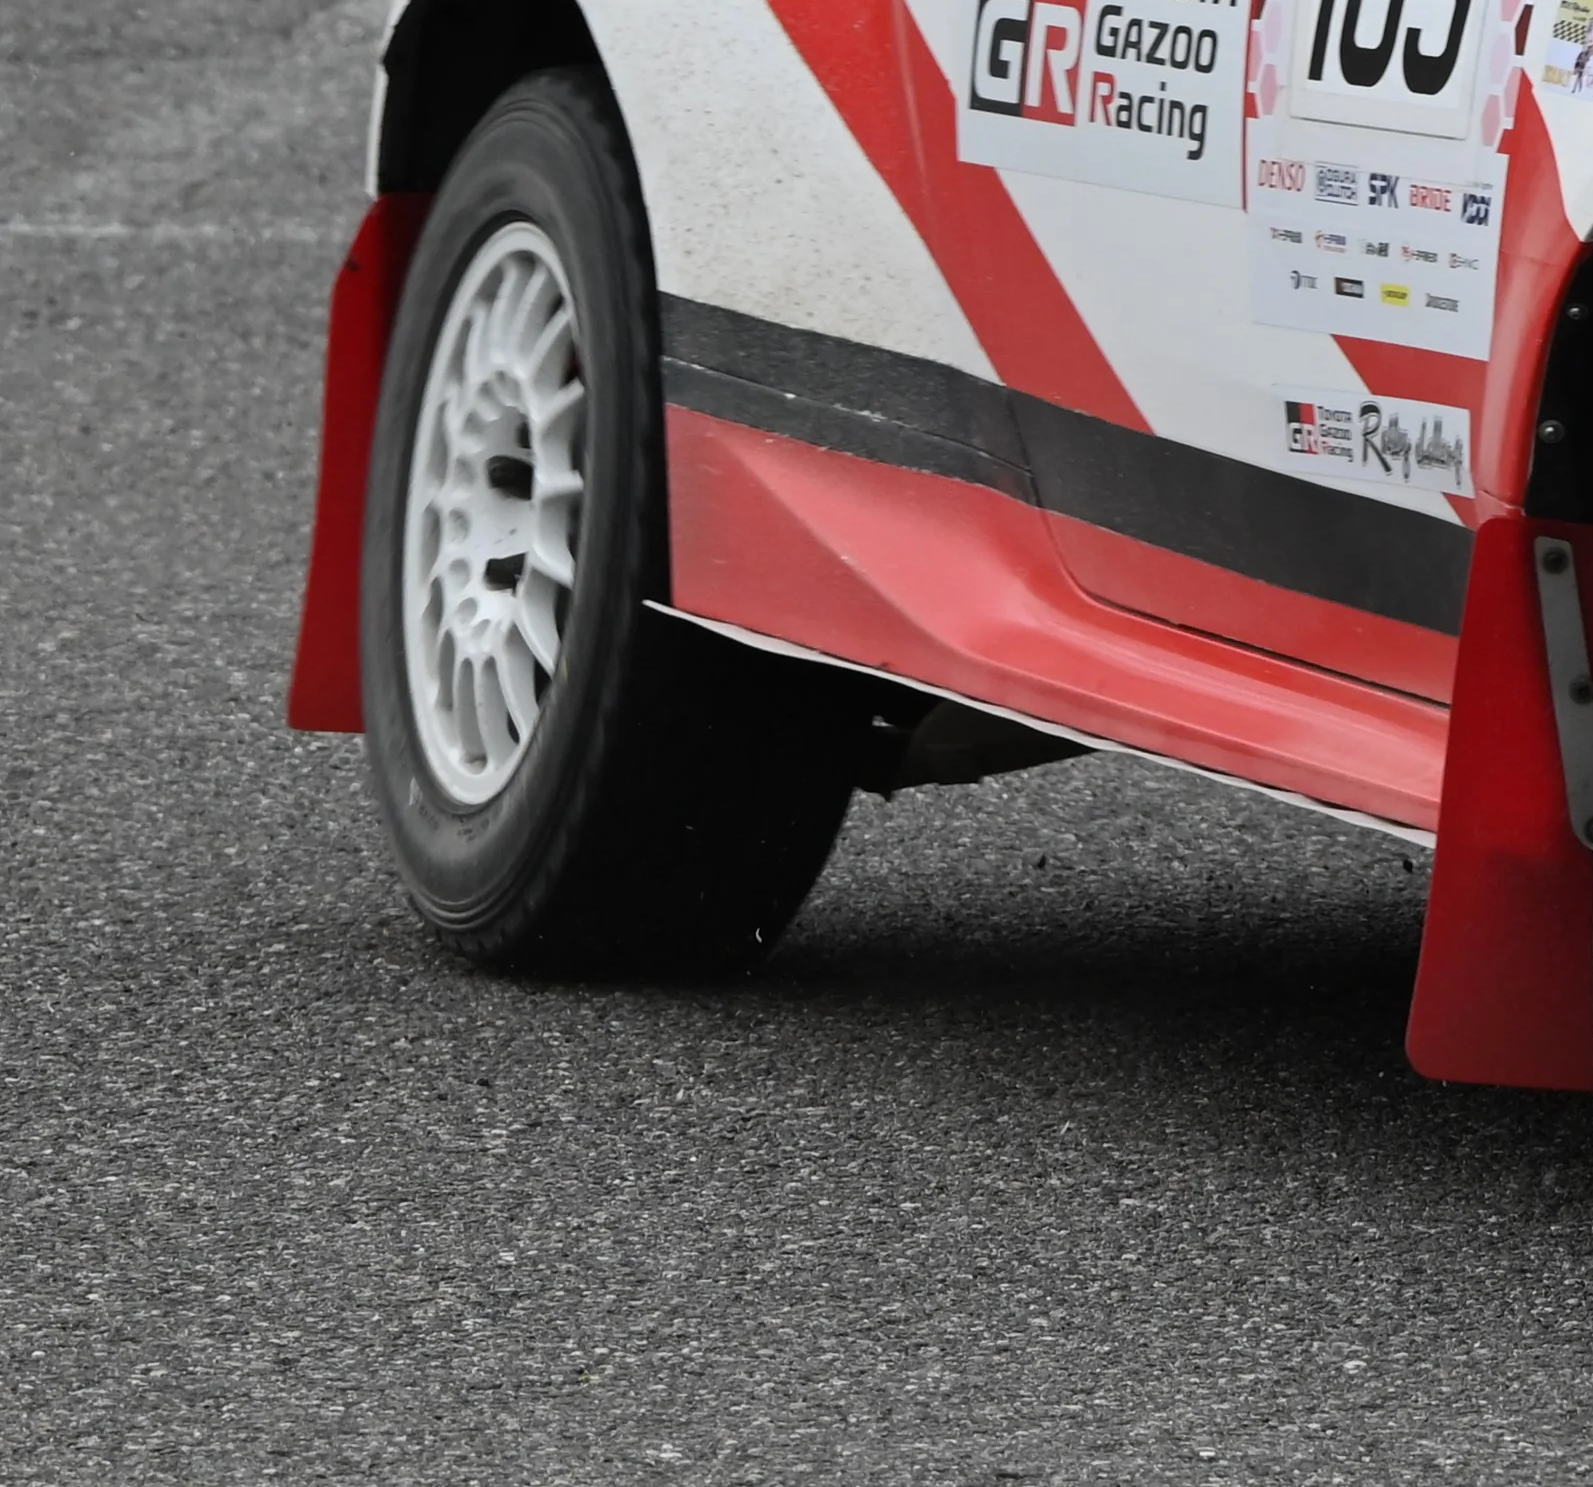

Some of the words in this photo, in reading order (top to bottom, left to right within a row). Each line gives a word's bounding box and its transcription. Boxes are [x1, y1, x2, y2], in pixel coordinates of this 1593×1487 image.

[1095, 5, 1219, 75] GAZOO
[1088, 69, 1209, 161] Racing
[1257, 159, 1307, 193] DENSO
[1409, 183, 1453, 213] BRIDE
